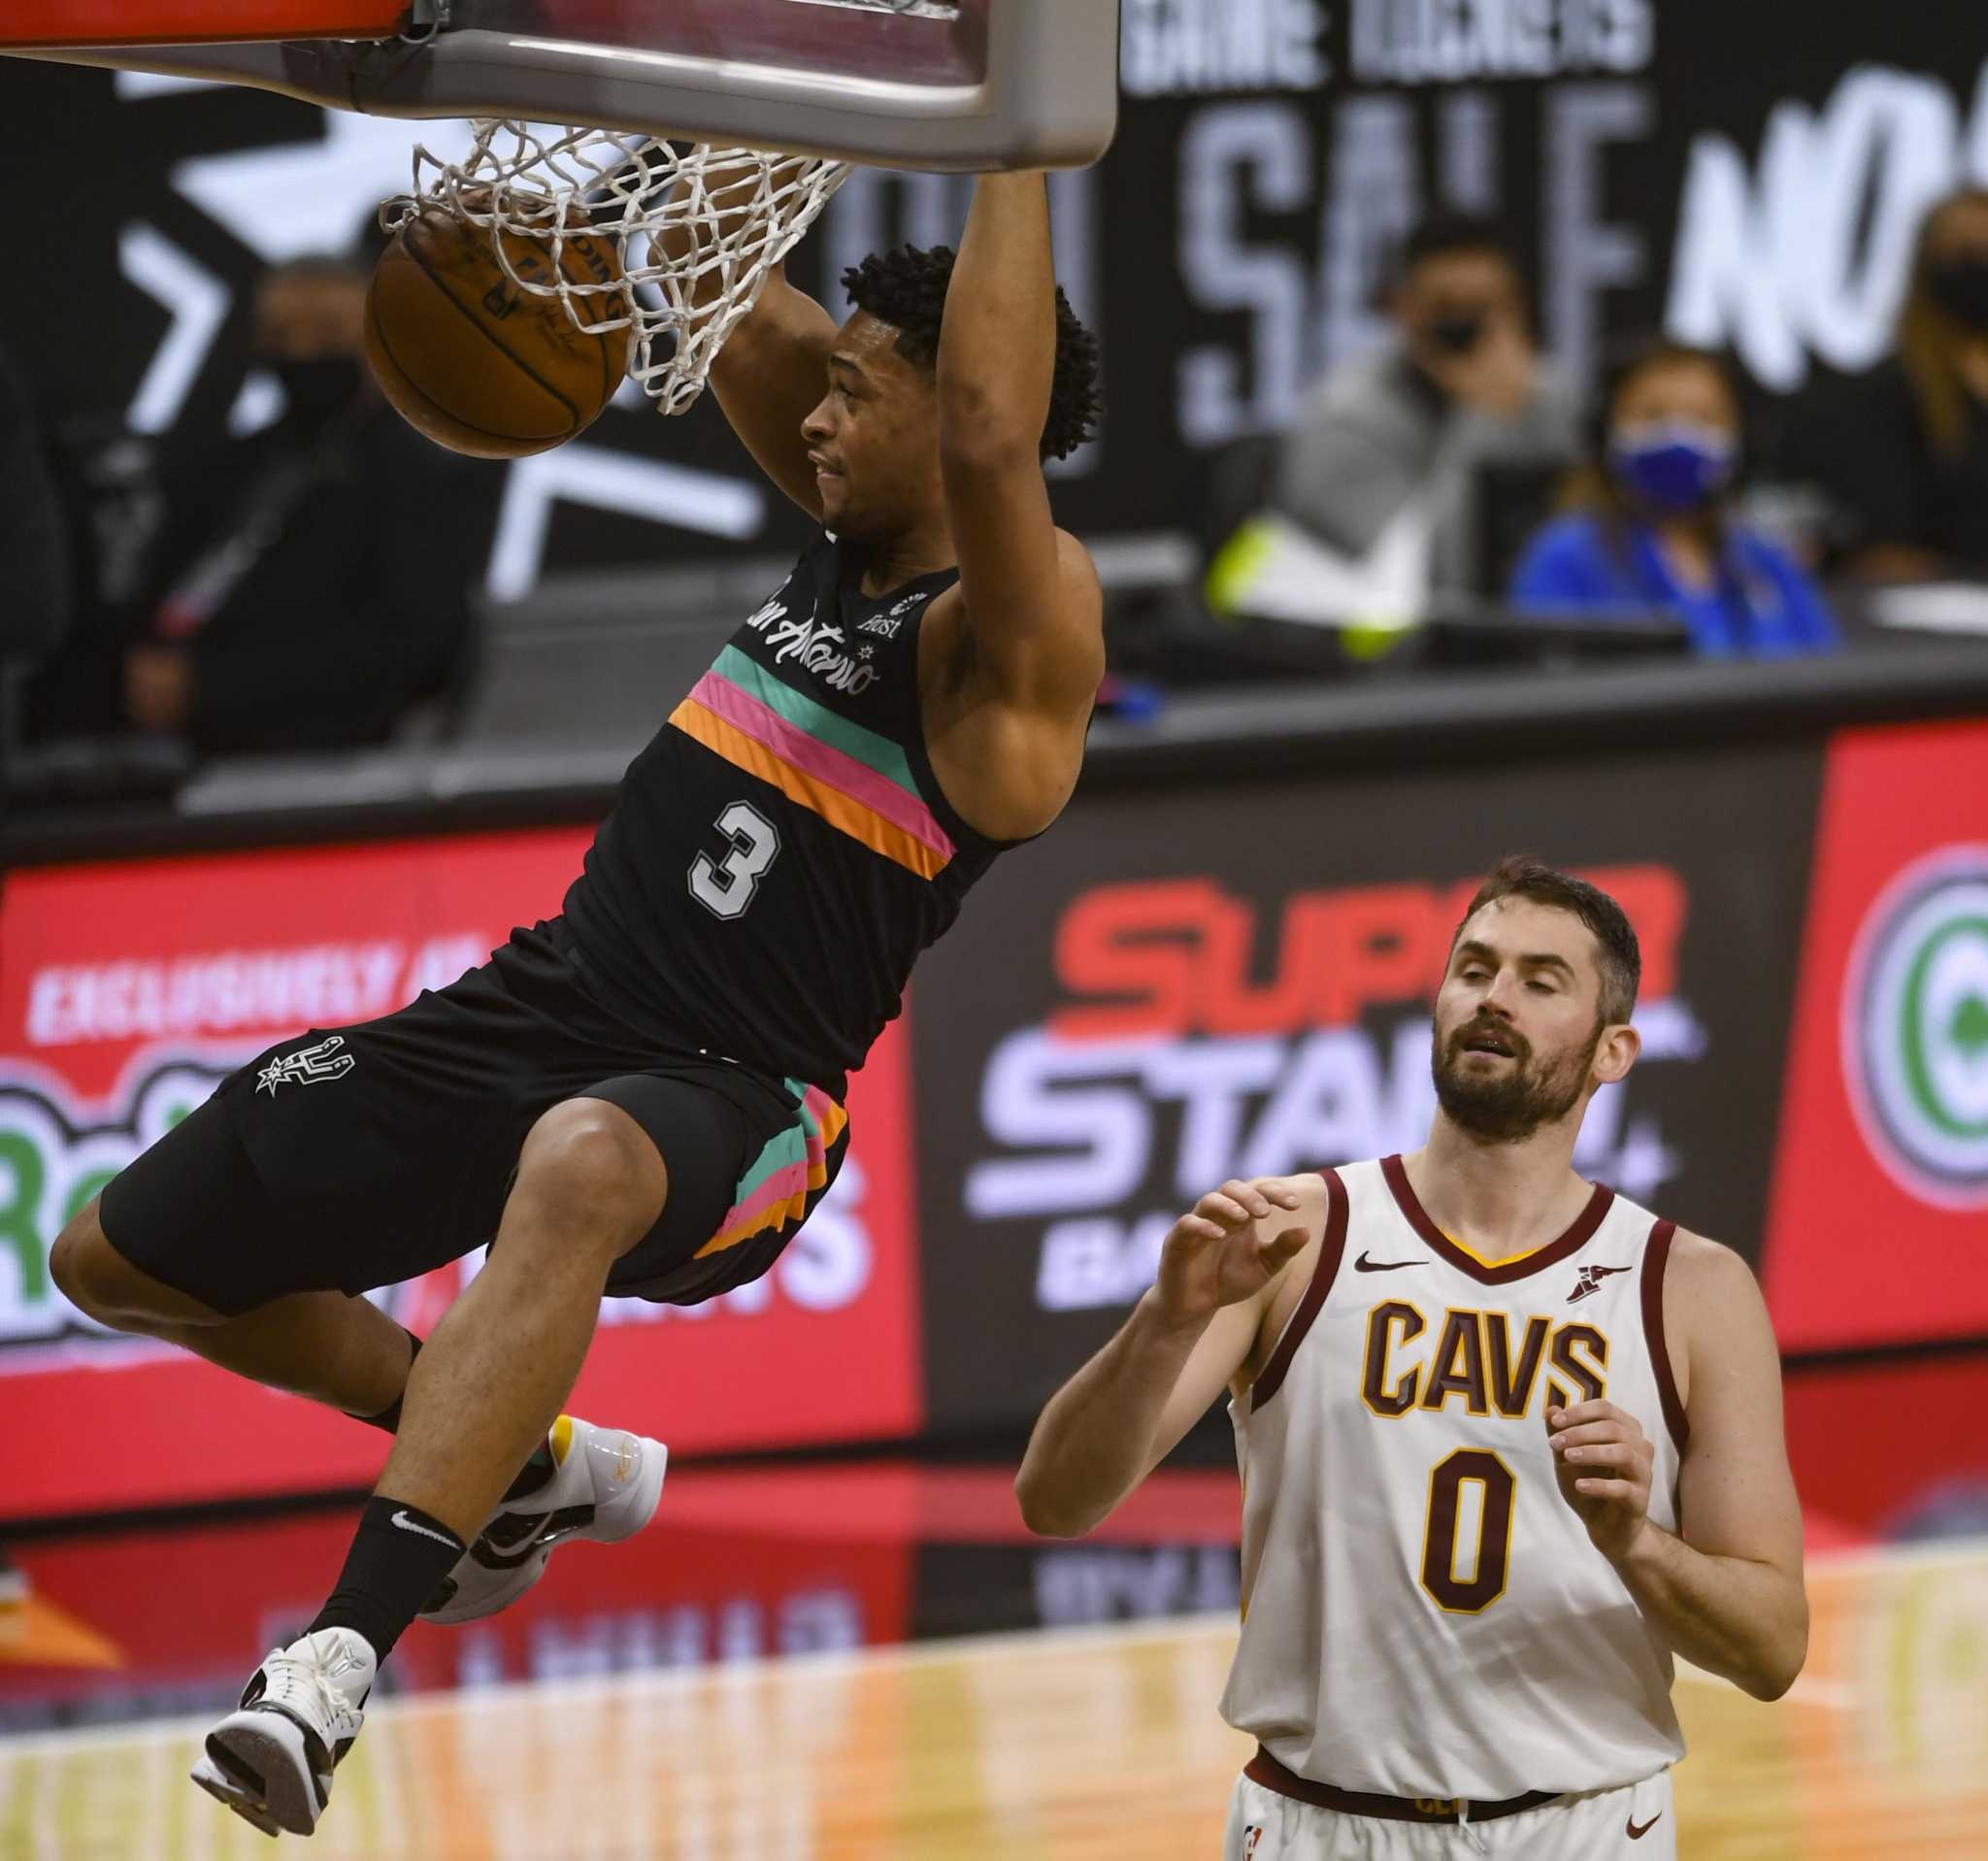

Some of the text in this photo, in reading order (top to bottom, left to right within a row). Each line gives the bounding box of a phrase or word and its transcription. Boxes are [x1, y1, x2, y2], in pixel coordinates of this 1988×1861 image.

[687, 800, 781, 920] 3
[1361, 1298, 1610, 1420] CAVS
[1418, 1446, 1517, 1615] 0
